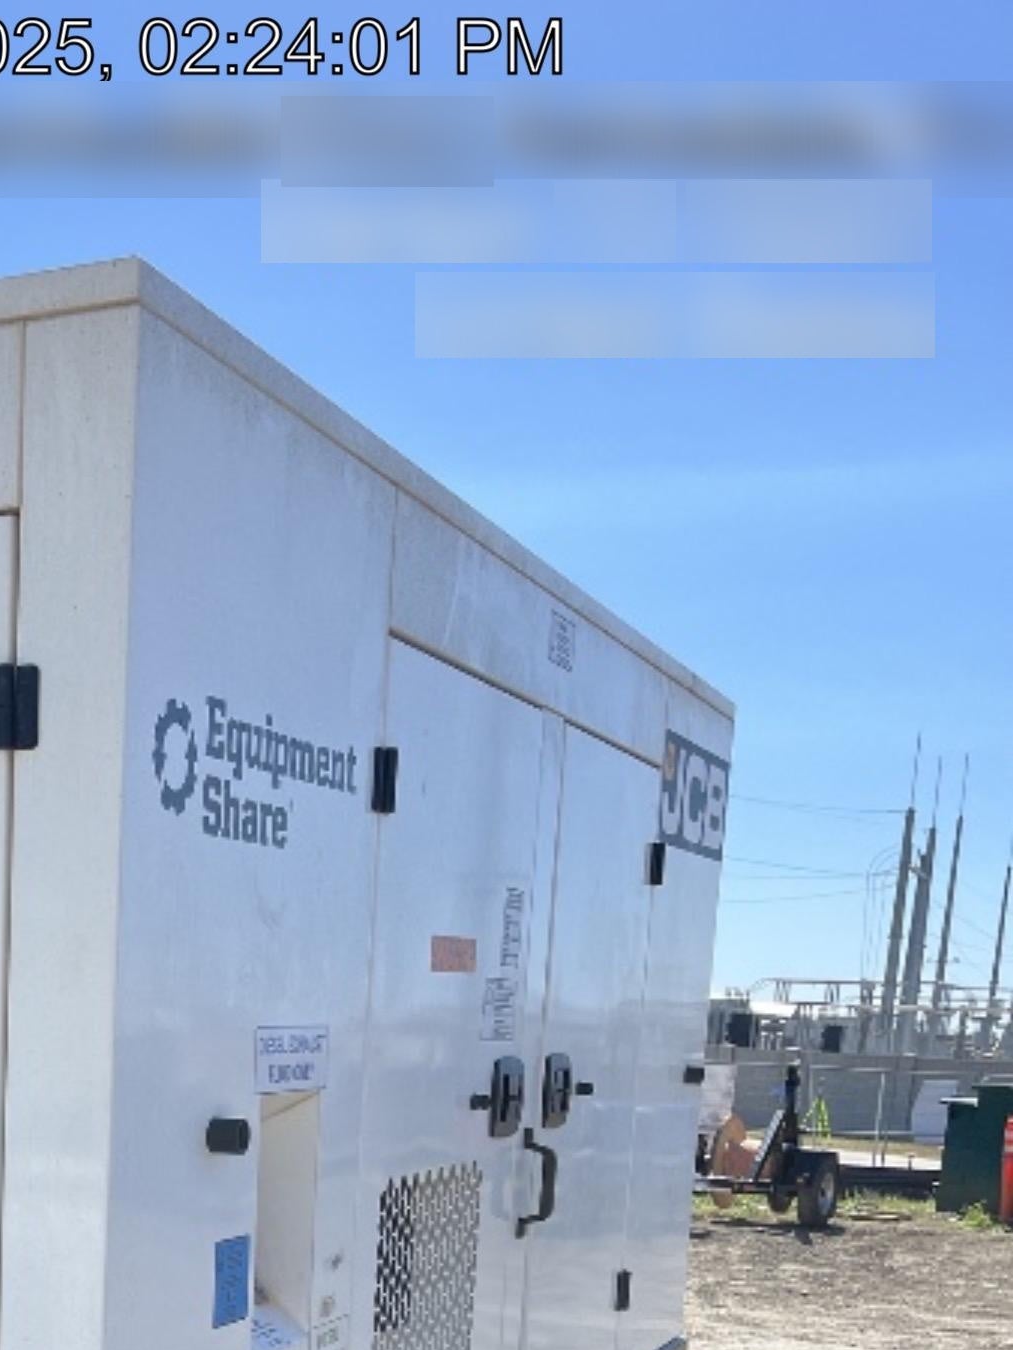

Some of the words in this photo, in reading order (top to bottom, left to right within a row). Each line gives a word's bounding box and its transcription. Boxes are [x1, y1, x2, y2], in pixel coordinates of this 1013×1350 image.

[204, 695, 357, 794] Equipment
[202, 774, 288, 849] Share
[661, 742, 727, 850] JCB
